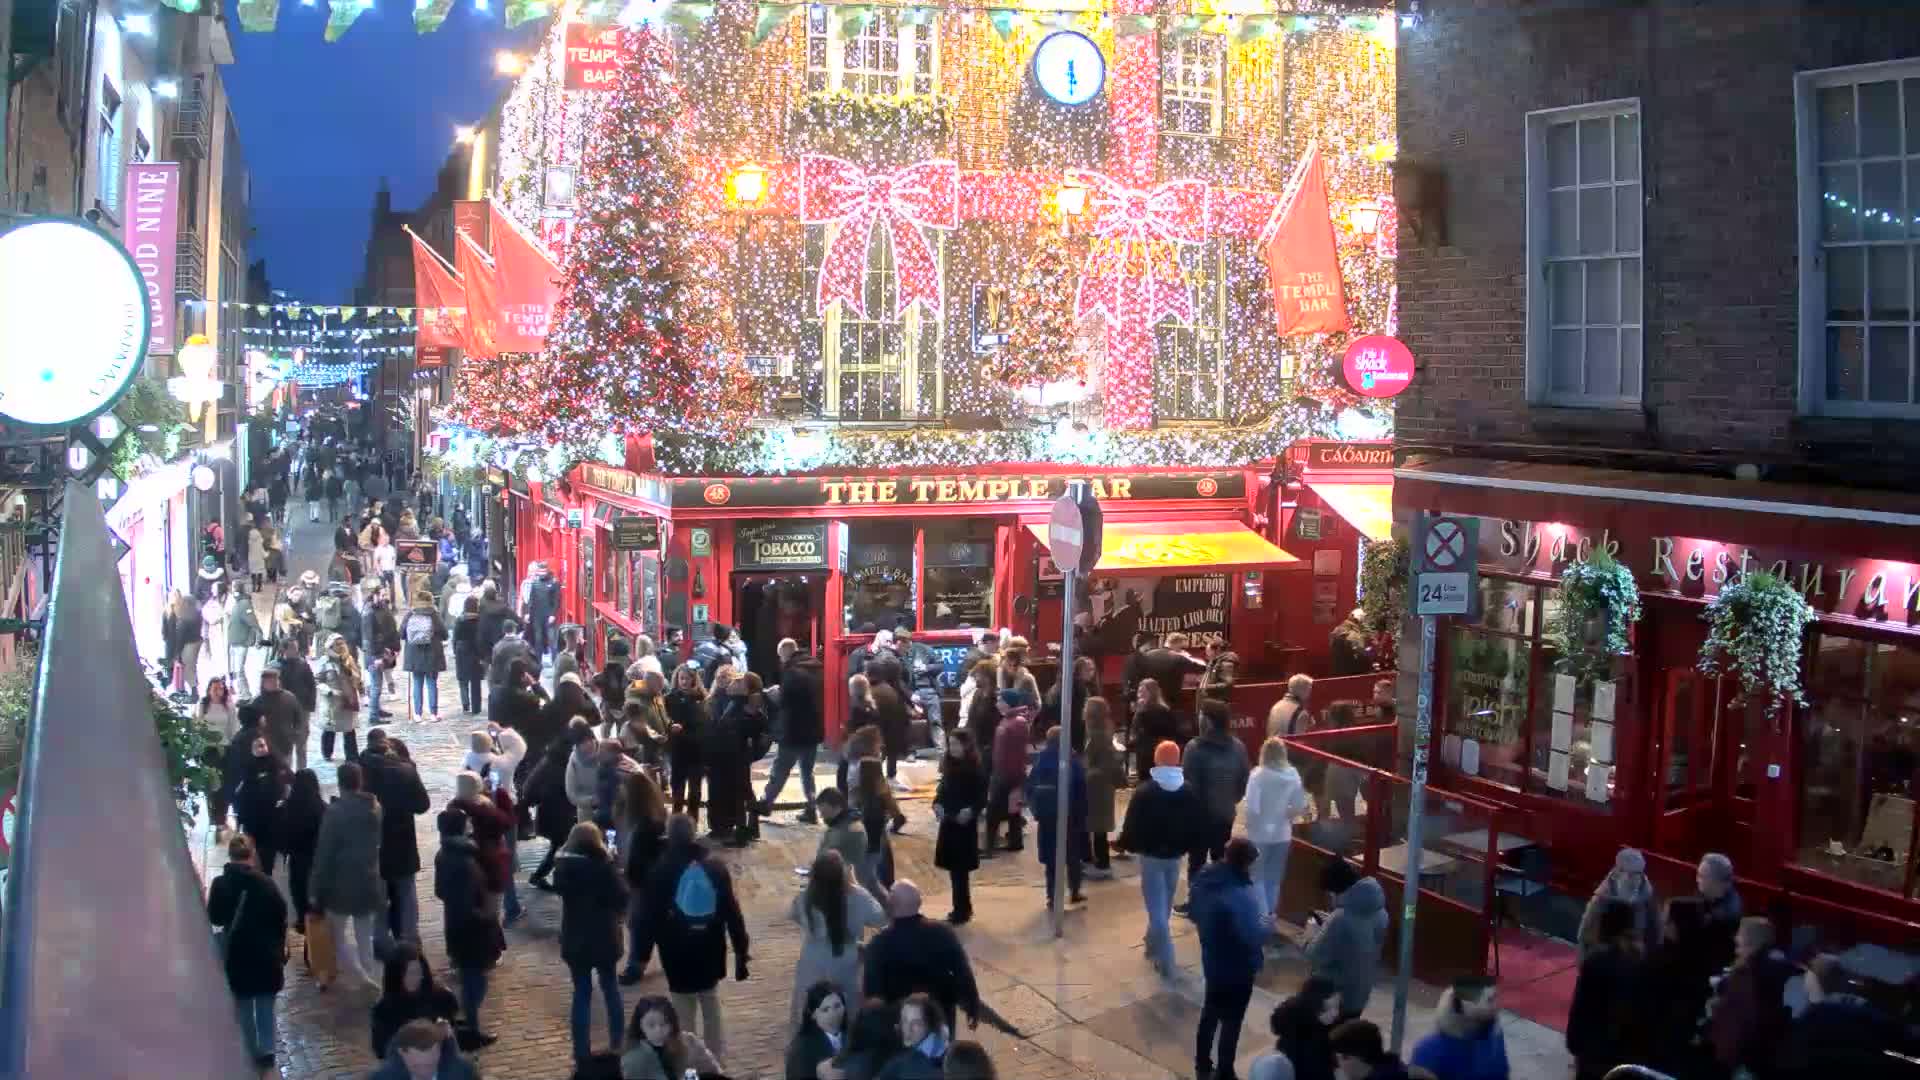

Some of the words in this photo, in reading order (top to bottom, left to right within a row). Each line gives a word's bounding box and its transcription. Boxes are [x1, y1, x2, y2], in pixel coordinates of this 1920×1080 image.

[567, 47, 624, 64] TEMPL
[136, 171, 169, 233] NINE
[1297, 271, 1325, 284] THE
[1300, 298, 1331, 313] BAR
[503, 311, 553, 325] TEMPL
[824, 481, 897, 503] THE
[912, 479, 1049, 502] TEMPLE
[750, 539, 816, 562] TOBACCO
[1500, 518, 1619, 567] Shack
[1175, 577, 1225, 592] EMPEROR
[1421, 583, 1443, 603] 24
[1211, 592, 1224, 607] OF
